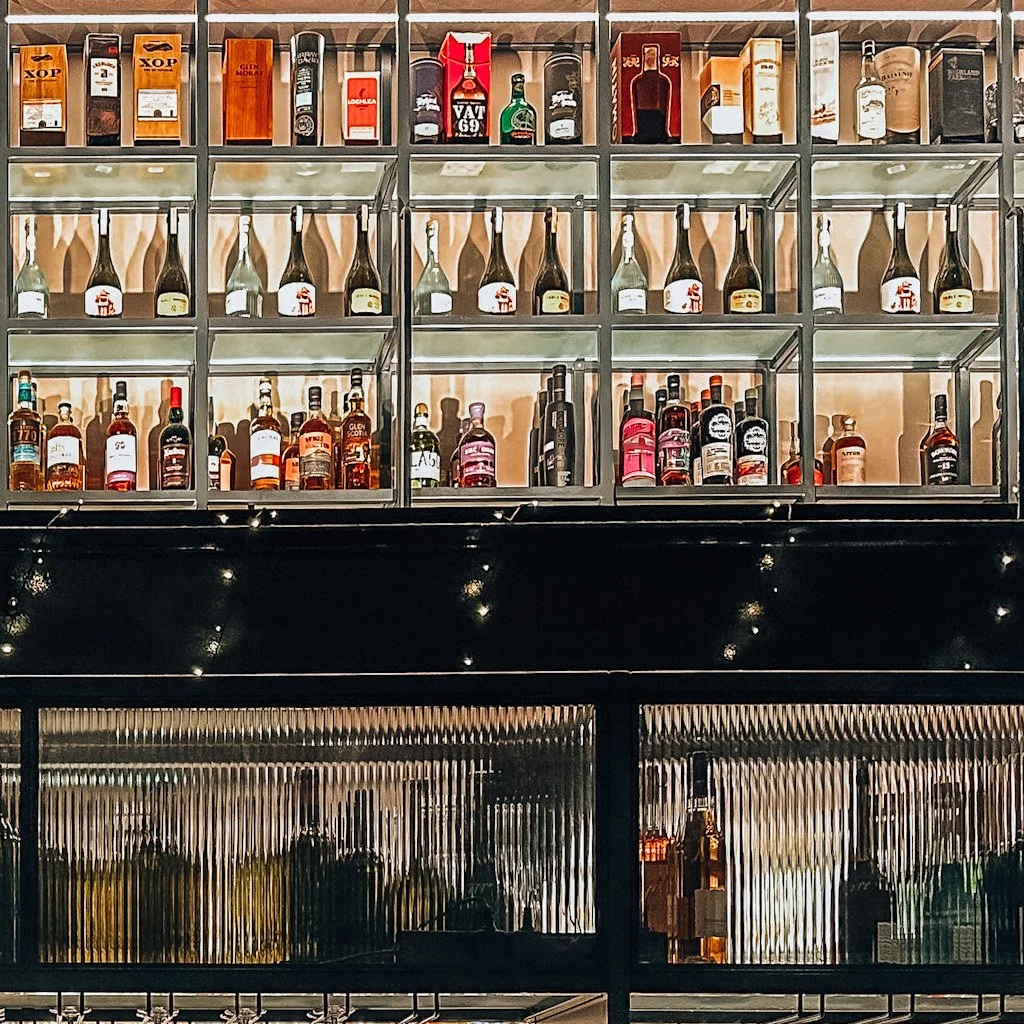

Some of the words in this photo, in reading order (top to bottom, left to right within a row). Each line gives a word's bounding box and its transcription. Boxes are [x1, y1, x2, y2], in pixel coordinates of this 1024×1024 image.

[138, 58, 178, 68] XOP
[239, 63, 260, 71] GLEN
[23, 68, 62, 79] XOP
[235, 69, 264, 77] MORAY
[452, 105, 486, 120] VAT
[458, 119, 480, 133] 69
[348, 423, 366, 431] GLEN
[12, 429, 37, 442] 1770
[347, 430, 368, 438] SCOTIA
